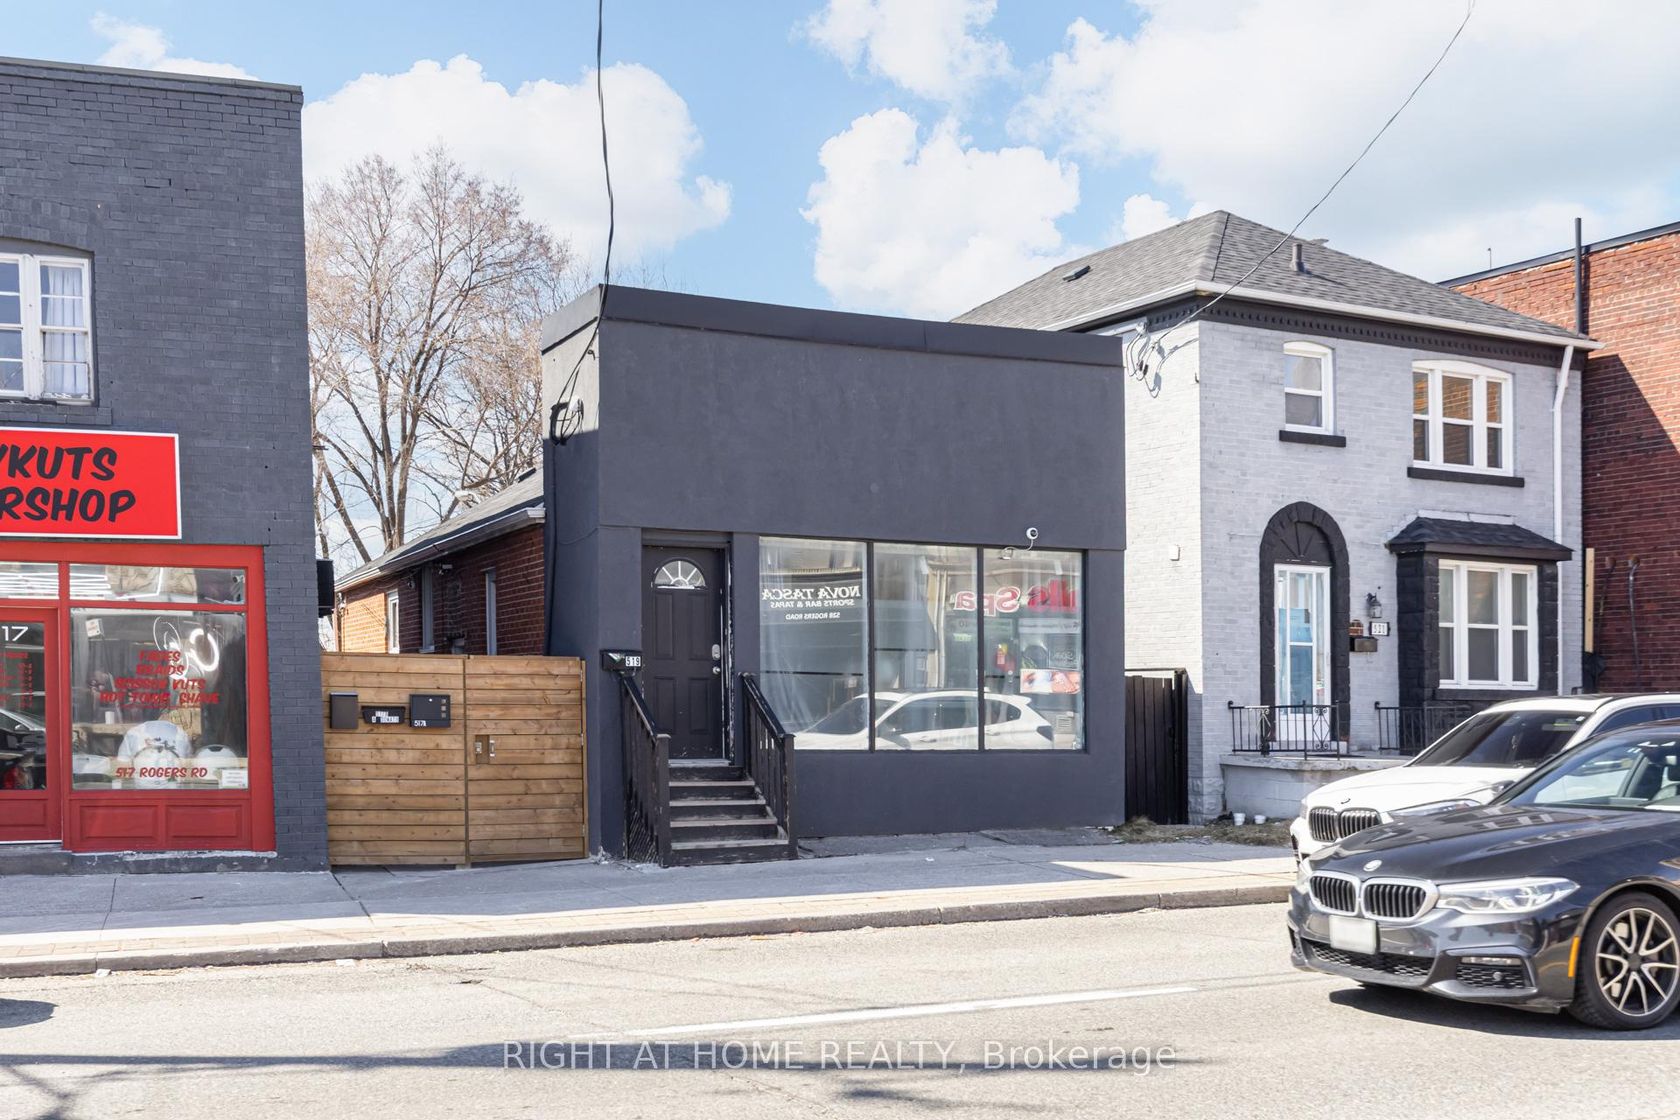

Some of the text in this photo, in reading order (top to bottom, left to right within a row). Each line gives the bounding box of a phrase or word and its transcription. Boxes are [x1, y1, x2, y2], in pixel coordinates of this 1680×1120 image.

[626, 657, 640, 666] 519
[115, 767, 208, 778] 517 ROGERS RD
